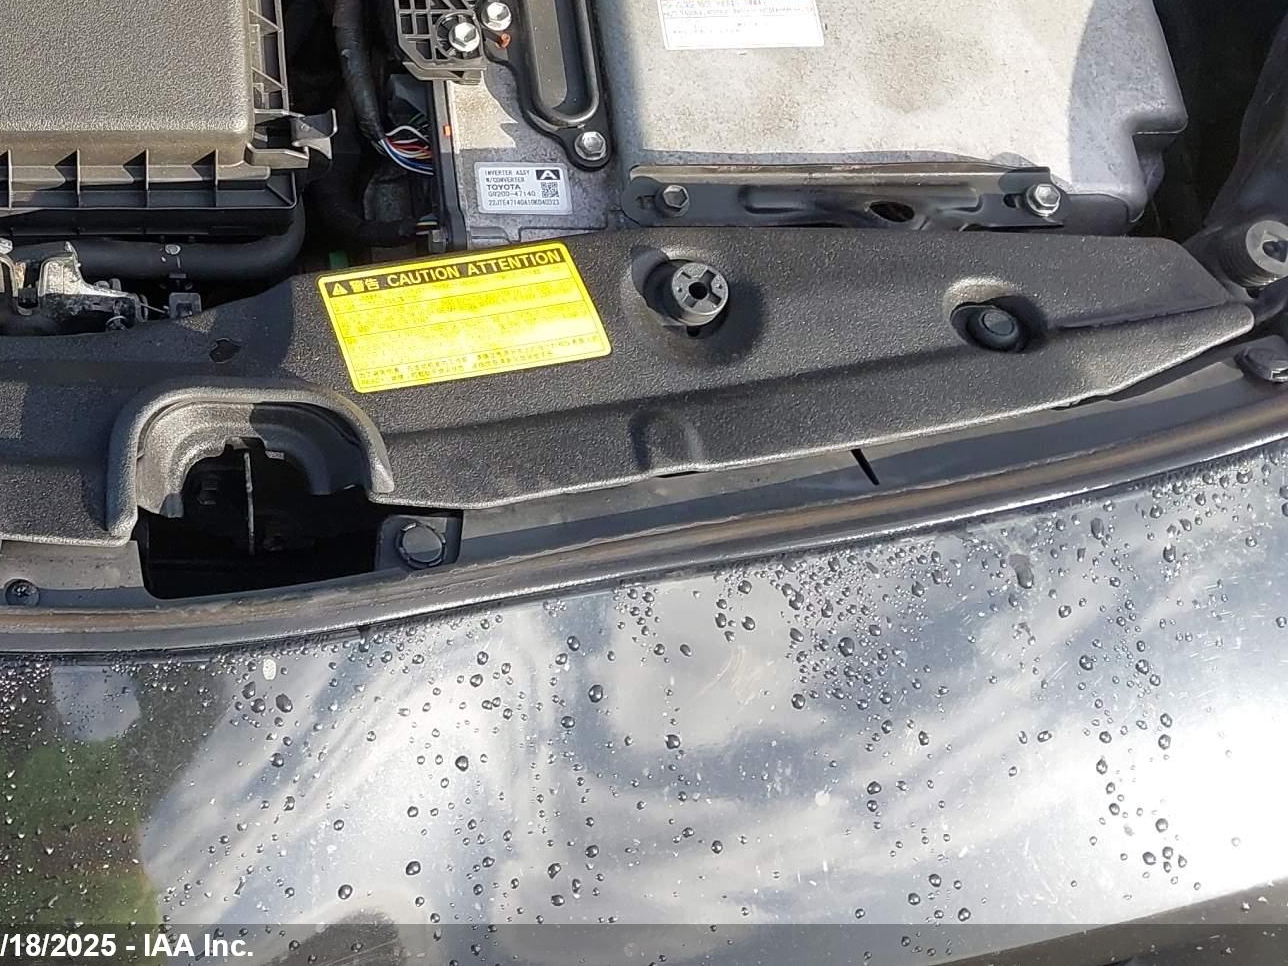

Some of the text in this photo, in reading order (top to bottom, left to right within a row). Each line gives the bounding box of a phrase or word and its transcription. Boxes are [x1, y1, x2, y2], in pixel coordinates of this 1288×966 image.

[349, 249, 562, 294] 警告 CAUTION ATTENTION
